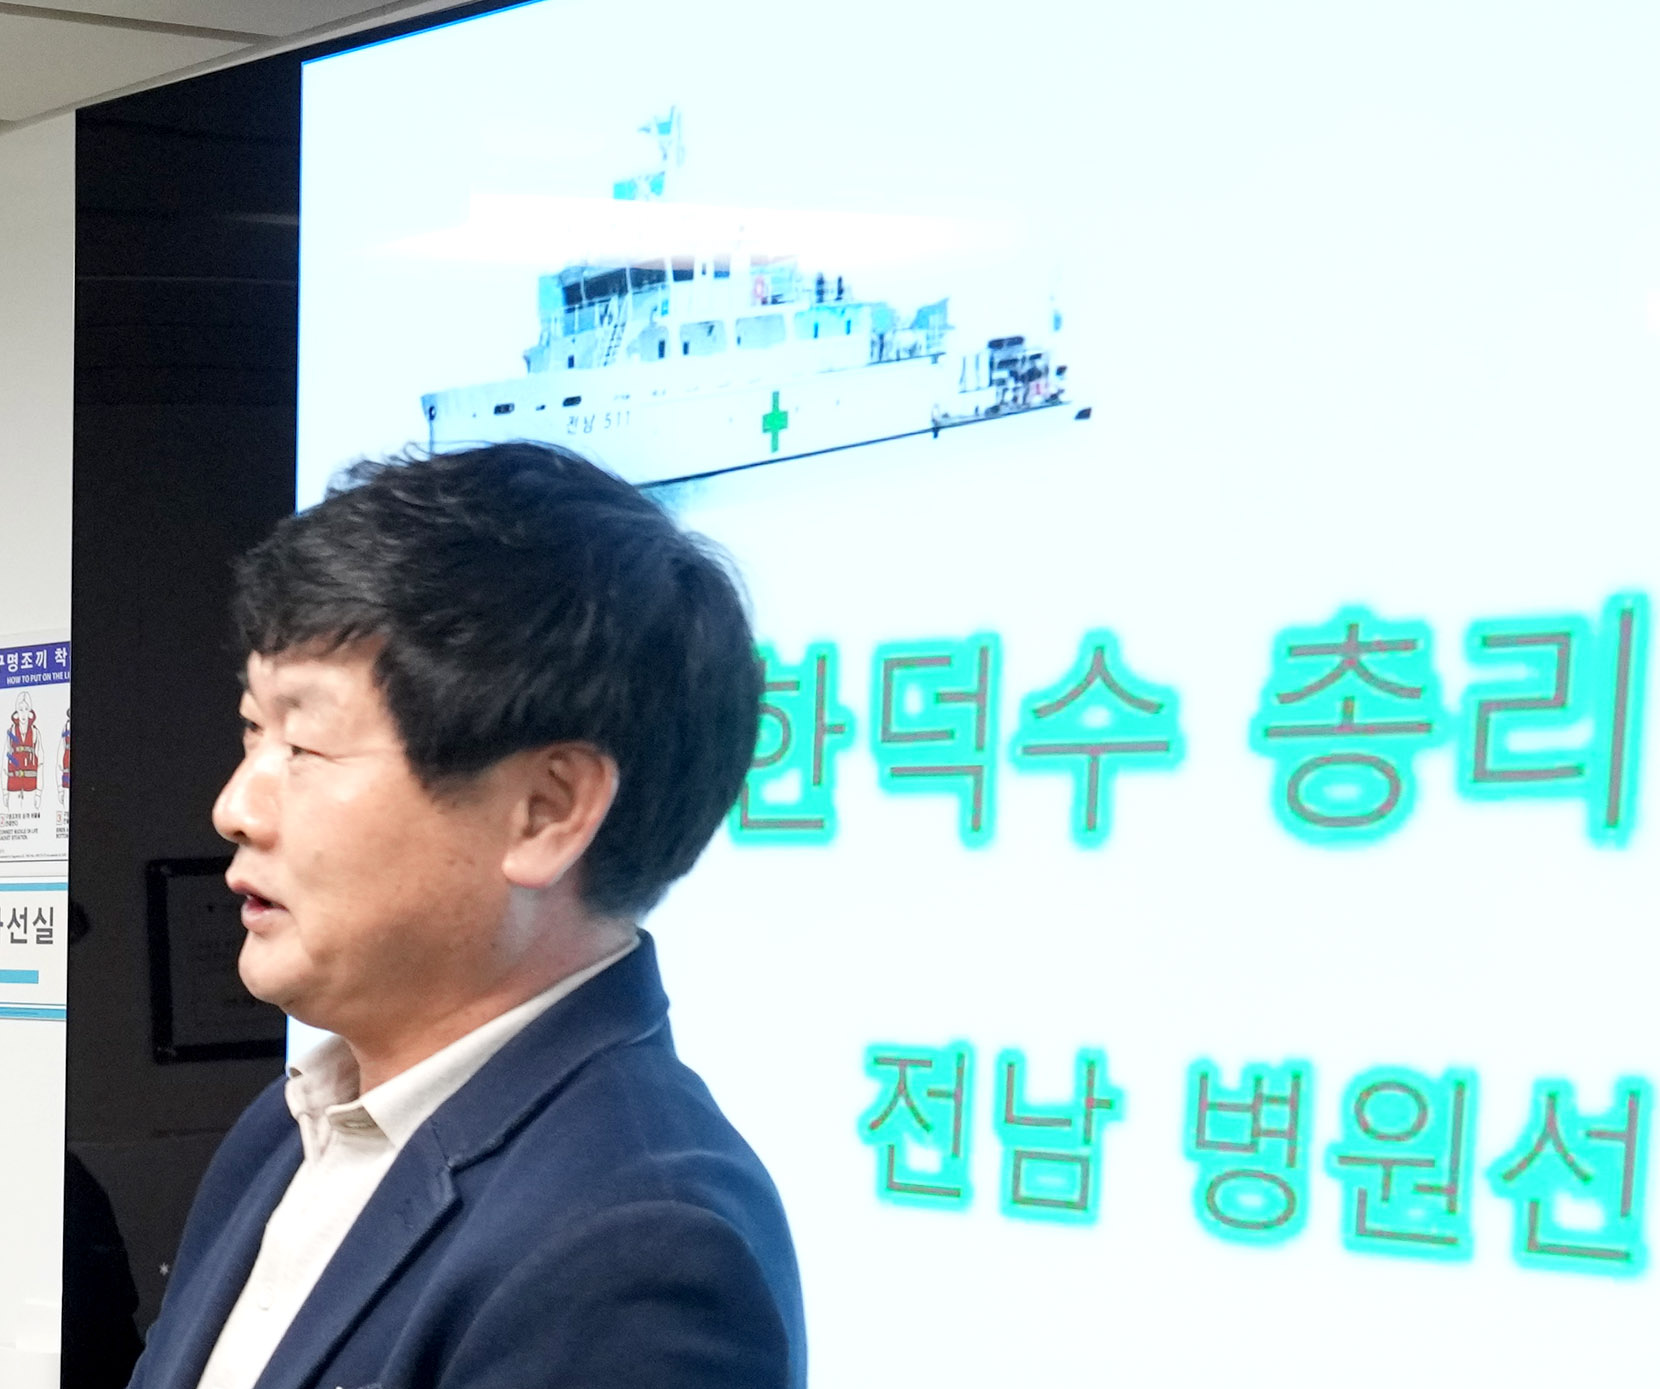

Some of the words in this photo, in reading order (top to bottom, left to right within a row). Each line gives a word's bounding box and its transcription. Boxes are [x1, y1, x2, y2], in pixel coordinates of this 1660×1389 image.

[22, 675, 29, 684] TO
[52, 672, 62, 680] THE
[737, 630, 1182, 846] 한덕수
[1251, 594, 1647, 847] 총리
[857, 1040, 1126, 1224] 전남
[1186, 1057, 1654, 1276] 병원선
